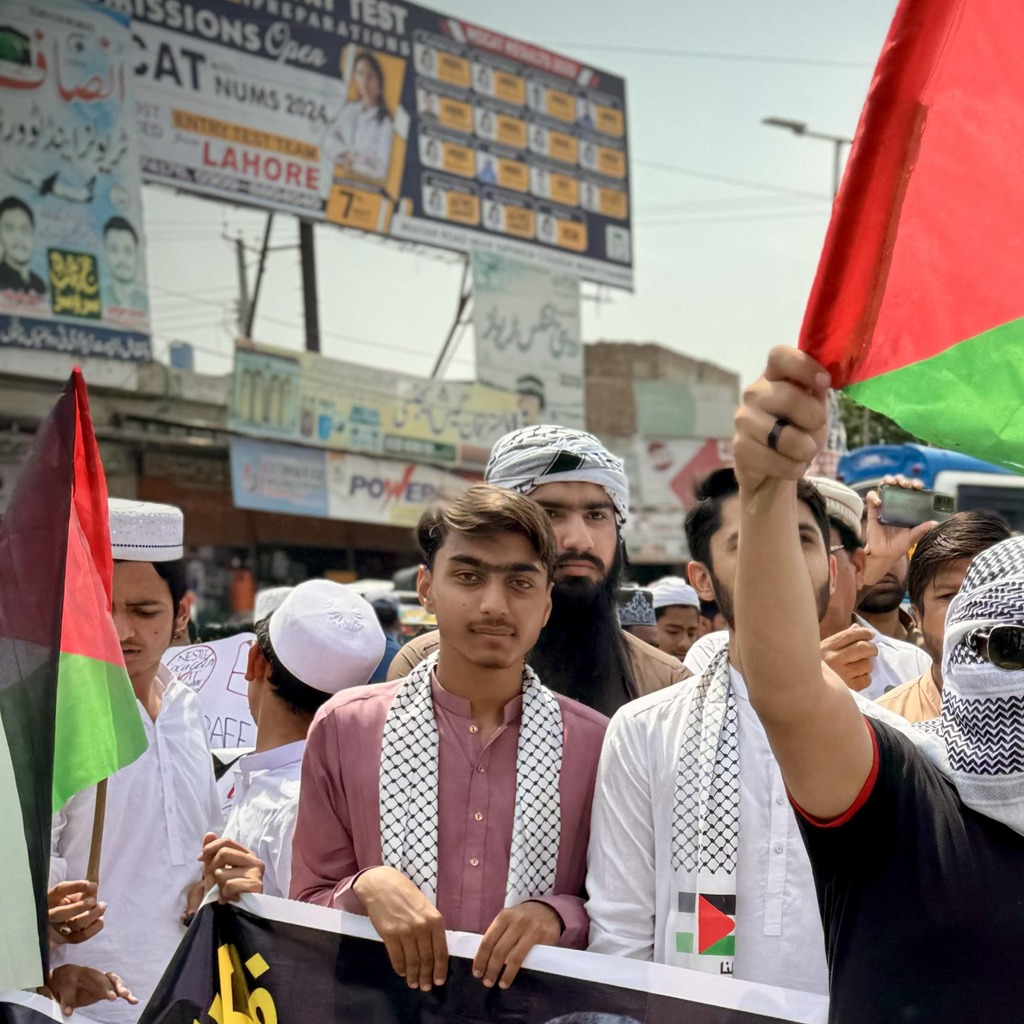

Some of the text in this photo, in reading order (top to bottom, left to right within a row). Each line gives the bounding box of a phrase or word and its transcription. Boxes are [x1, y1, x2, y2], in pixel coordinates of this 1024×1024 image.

[134, 0, 262, 52] ISSIONS
[264, 21, 329, 68] Open
[215, 75, 282, 112] NUMS
[202, 140, 321, 191] LAHORE
